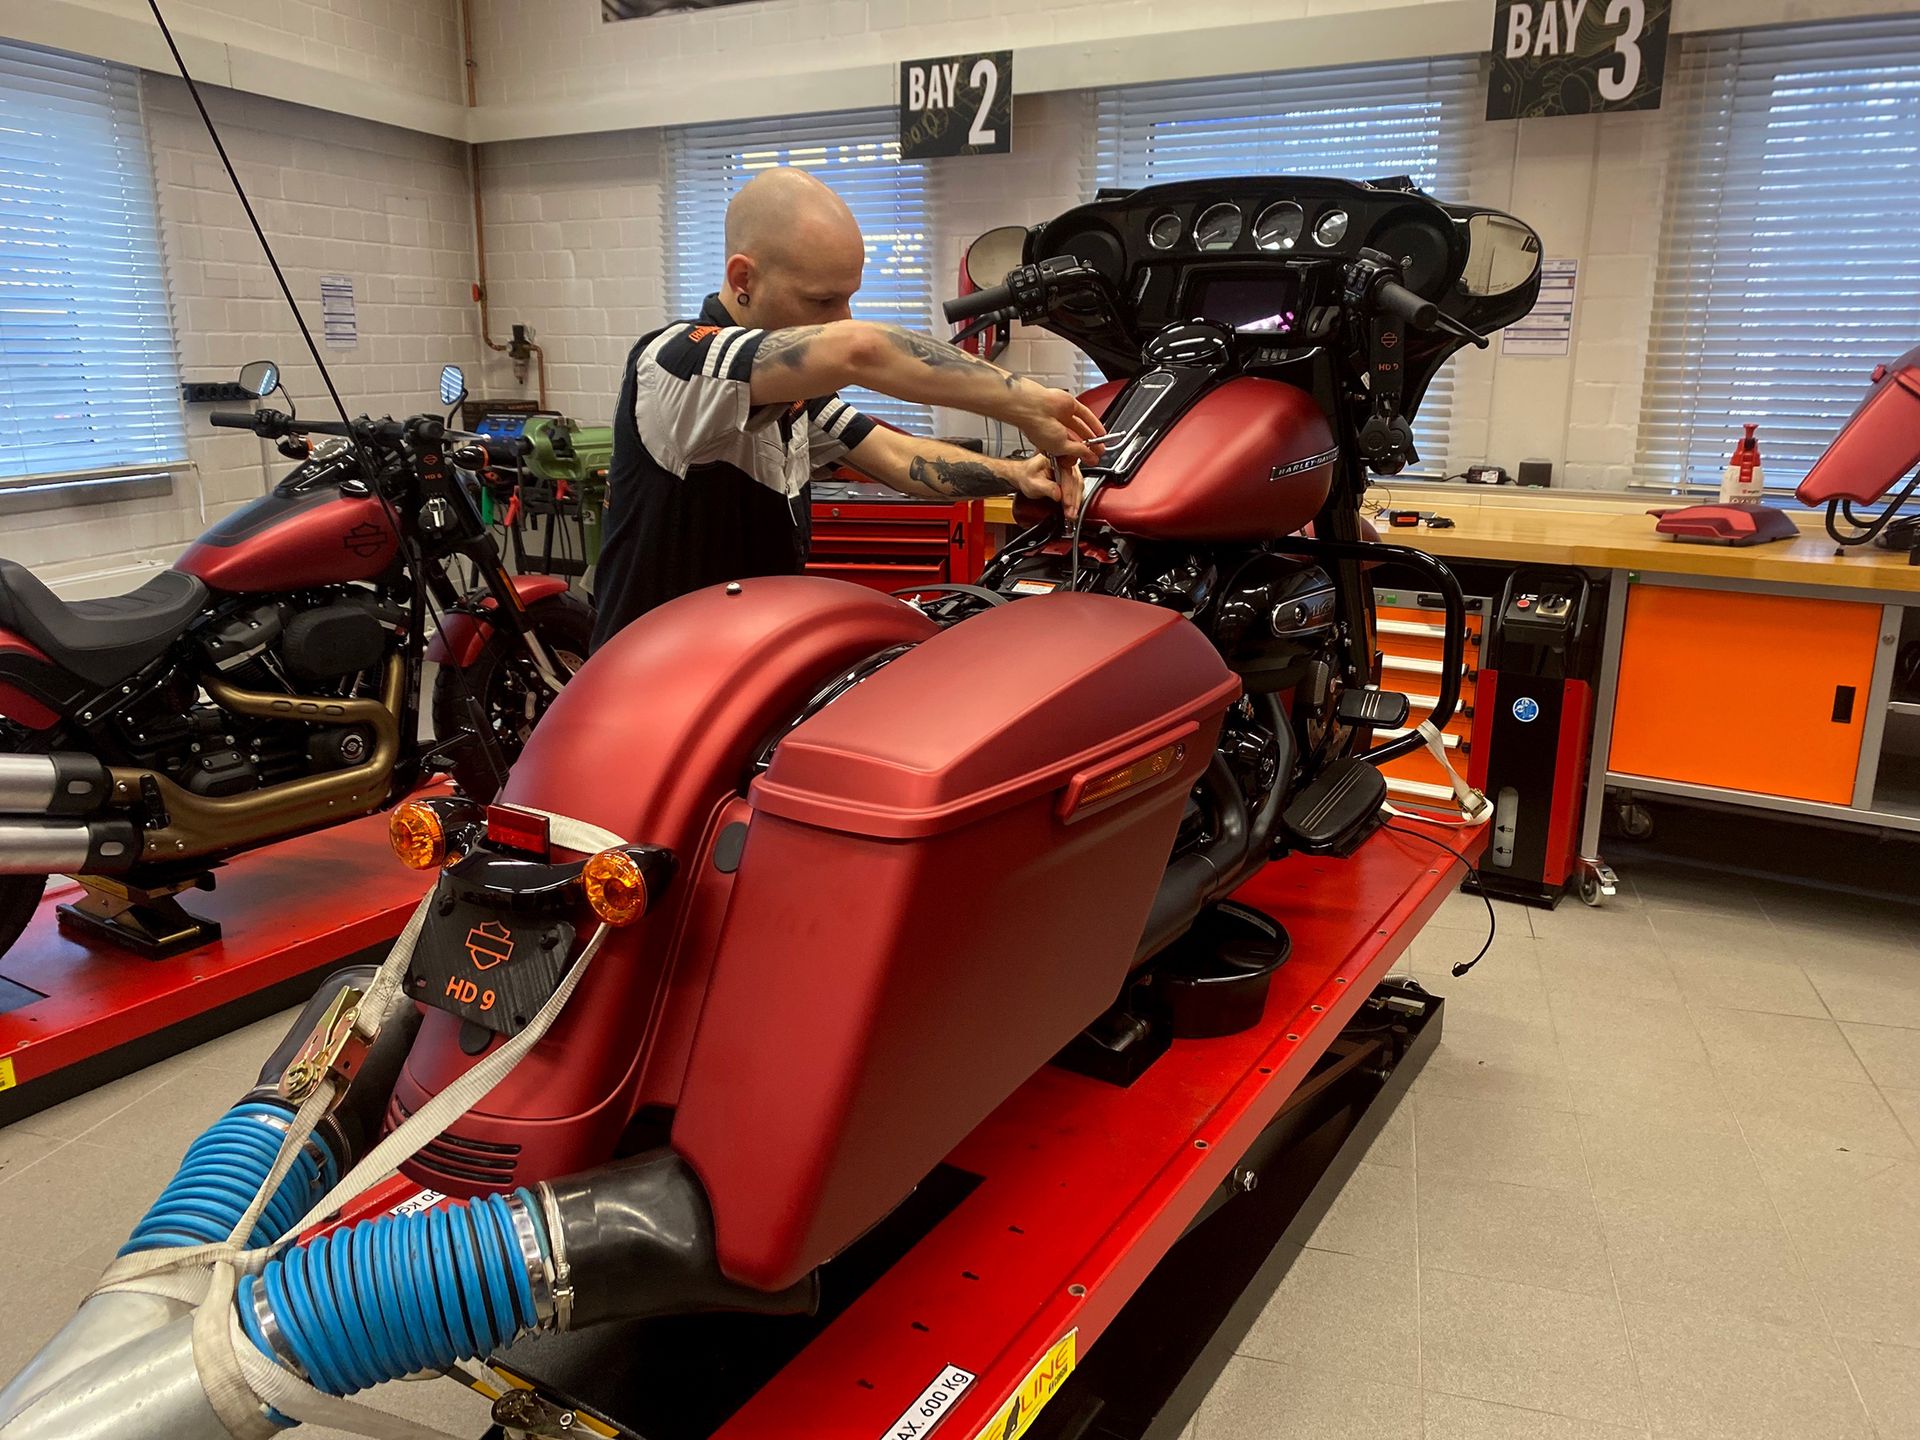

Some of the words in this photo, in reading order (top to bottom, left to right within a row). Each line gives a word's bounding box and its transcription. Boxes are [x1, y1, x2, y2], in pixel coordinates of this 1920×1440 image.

[1505, 0, 1587, 59] BAY
[1598, 0, 1646, 101] 3
[909, 62, 960, 111] BAY
[968, 58, 998, 145] 2
[1378, 363, 1391, 371] HD
[1278, 451, 1338, 476] HARLEY-DAV
[950, 521, 965, 550] 4
[446, 975, 478, 1003] HD
[479, 989, 496, 1011] 9
[1021, 1341, 1068, 1413] LINE
[892, 1420, 925, 1440] AX.
[919, 1390, 949, 1417] 600
[941, 1372, 969, 1391] Kg
